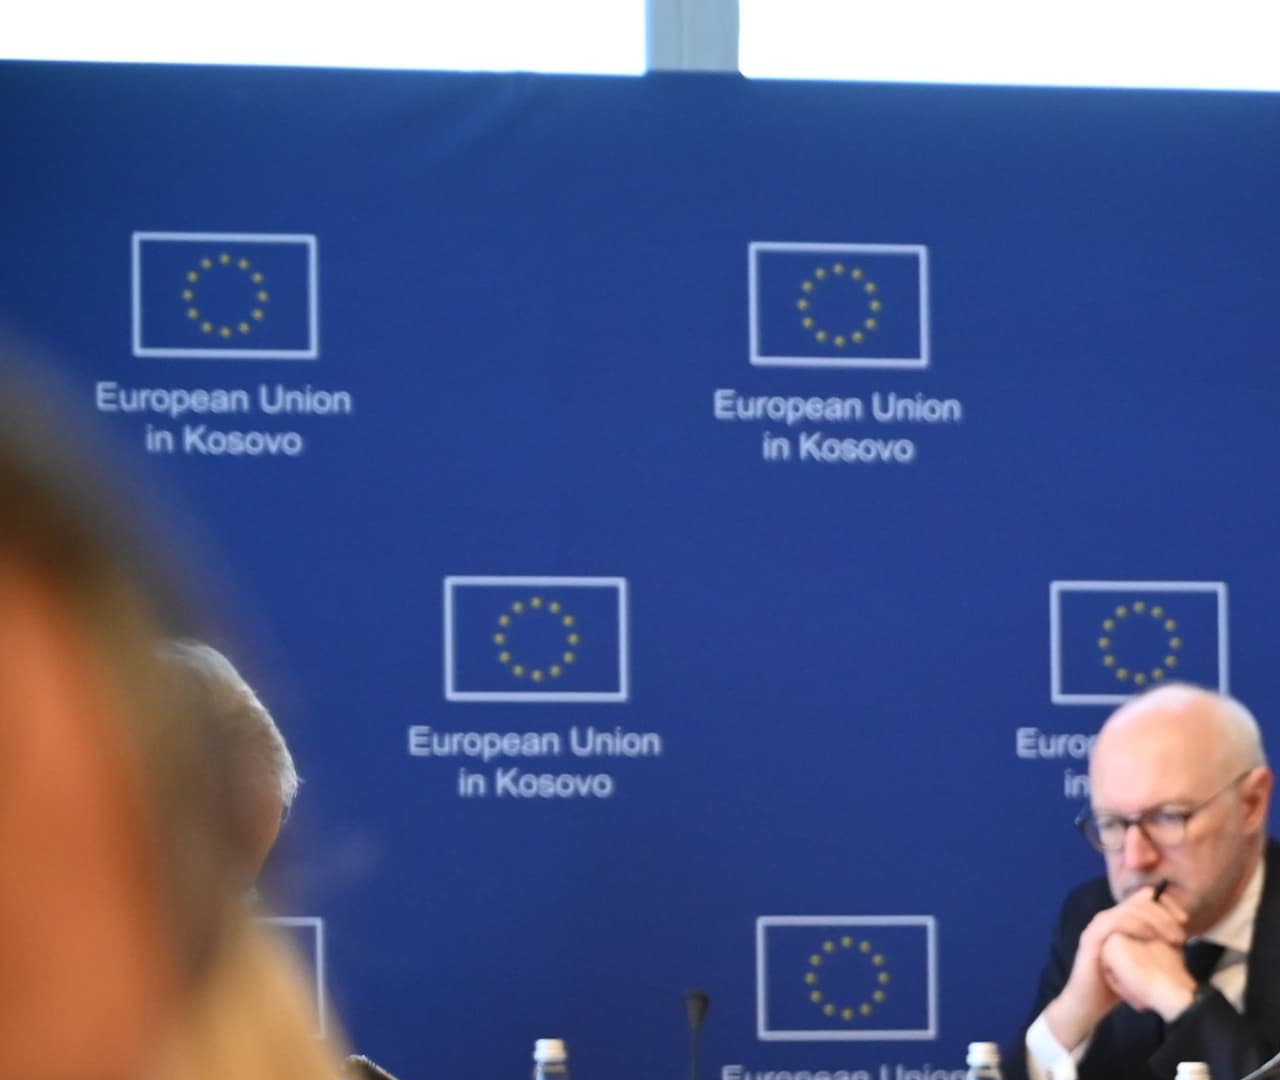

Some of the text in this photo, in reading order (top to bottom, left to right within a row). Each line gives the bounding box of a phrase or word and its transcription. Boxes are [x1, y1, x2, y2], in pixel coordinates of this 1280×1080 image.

[95, 382, 352, 418] European Union
[713, 389, 962, 426] European Union
[146, 425, 303, 455] in Kosovo
[763, 432, 915, 463] in Kosovo
[409, 726, 661, 761] European Union
[458, 768, 614, 798] in Kosovo
